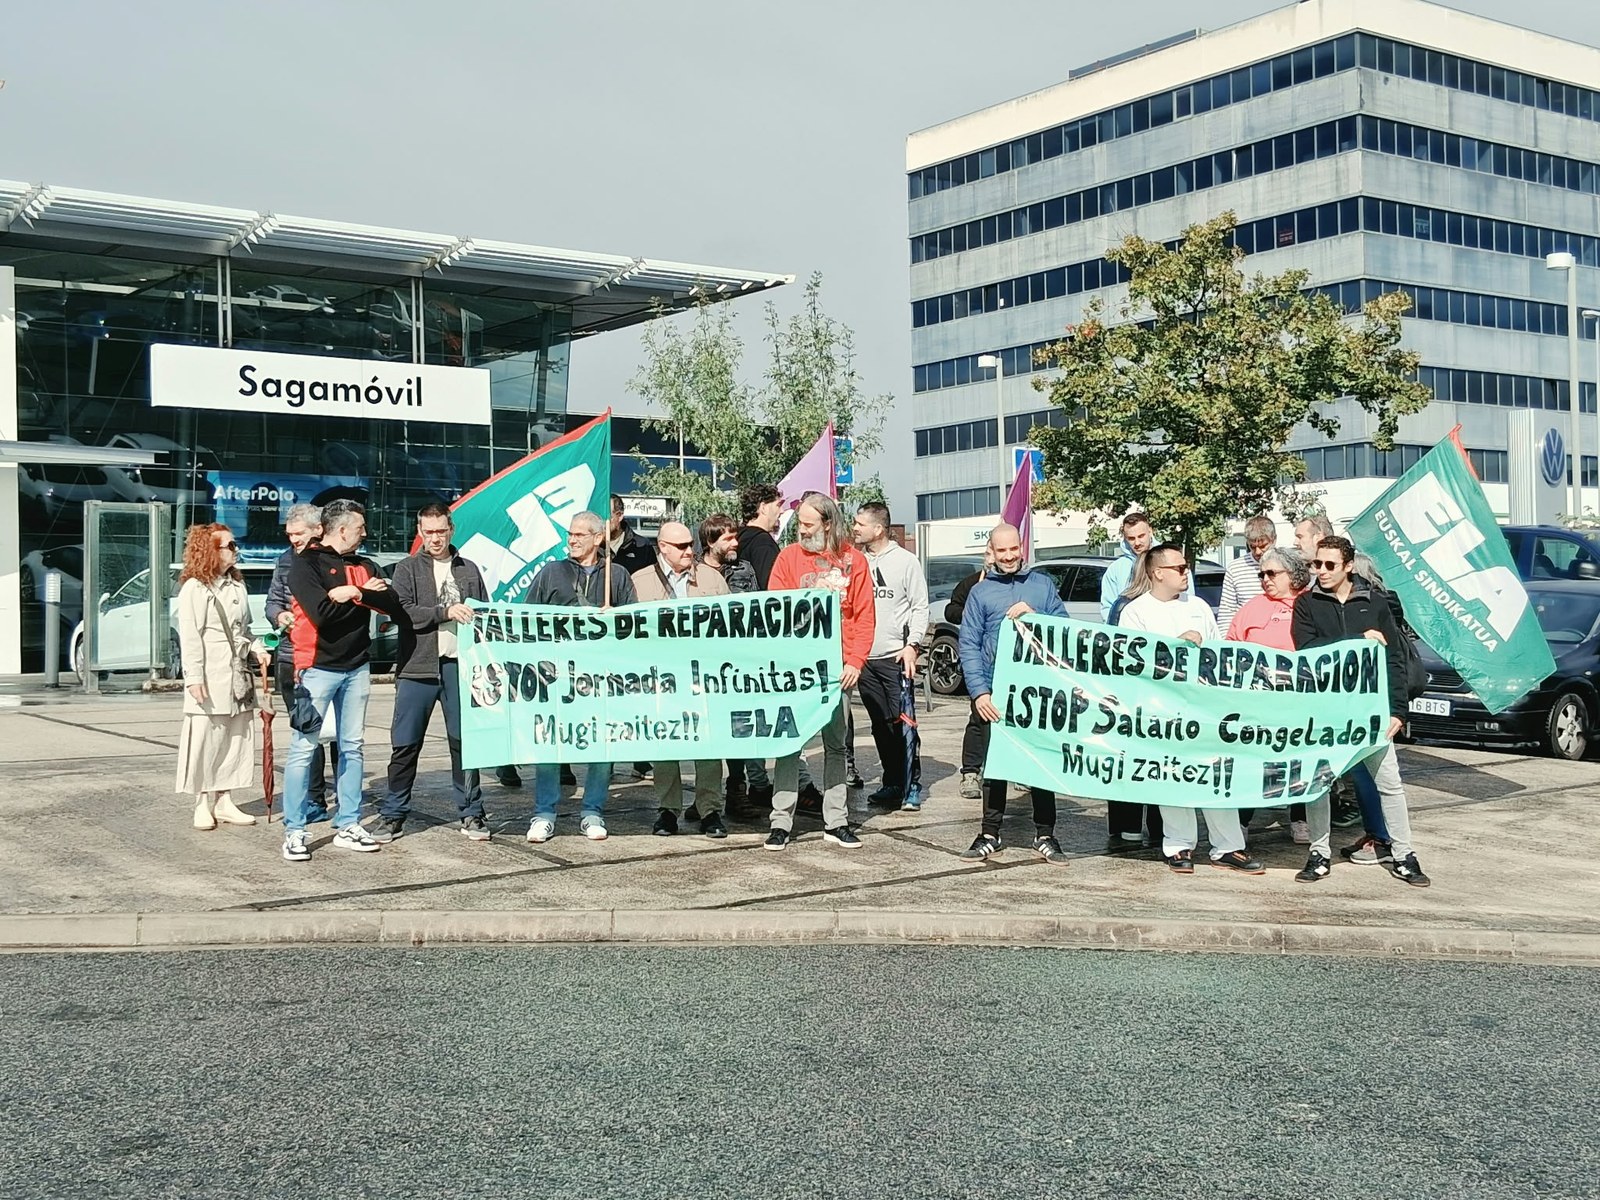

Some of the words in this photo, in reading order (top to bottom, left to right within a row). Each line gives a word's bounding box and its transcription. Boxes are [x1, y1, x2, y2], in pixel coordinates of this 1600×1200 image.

[238, 364, 423, 408] Sagamóvil
[213, 485, 295, 501] AfterPolo
[1374, 509, 1418, 571] EUSKAL
[1414, 569, 1499, 653] SINDIKATUA
[1388, 471, 1528, 642] ELA
[473, 607, 608, 643] TALLERES
[614, 609, 649, 640] DE
[657, 591, 833, 639] REPARACIÓN
[1012, 619, 1148, 677] TALLERES
[1152, 640, 1189, 682] DE
[1198, 644, 1379, 694] REPARACION
[534, 714, 597, 750] Mugi
[604, 711, 700, 743] zaitez!!
[730, 706, 800, 739] ELA
[1005, 684, 1090, 734] ¡STOP
[1091, 694, 1200, 742] Salario
[1425, 701, 1446, 714] BTS
[1061, 743, 1126, 785] Mugi
[1130, 756, 1235, 798] zaitez!!
[1262, 758, 1337, 800] ELA
